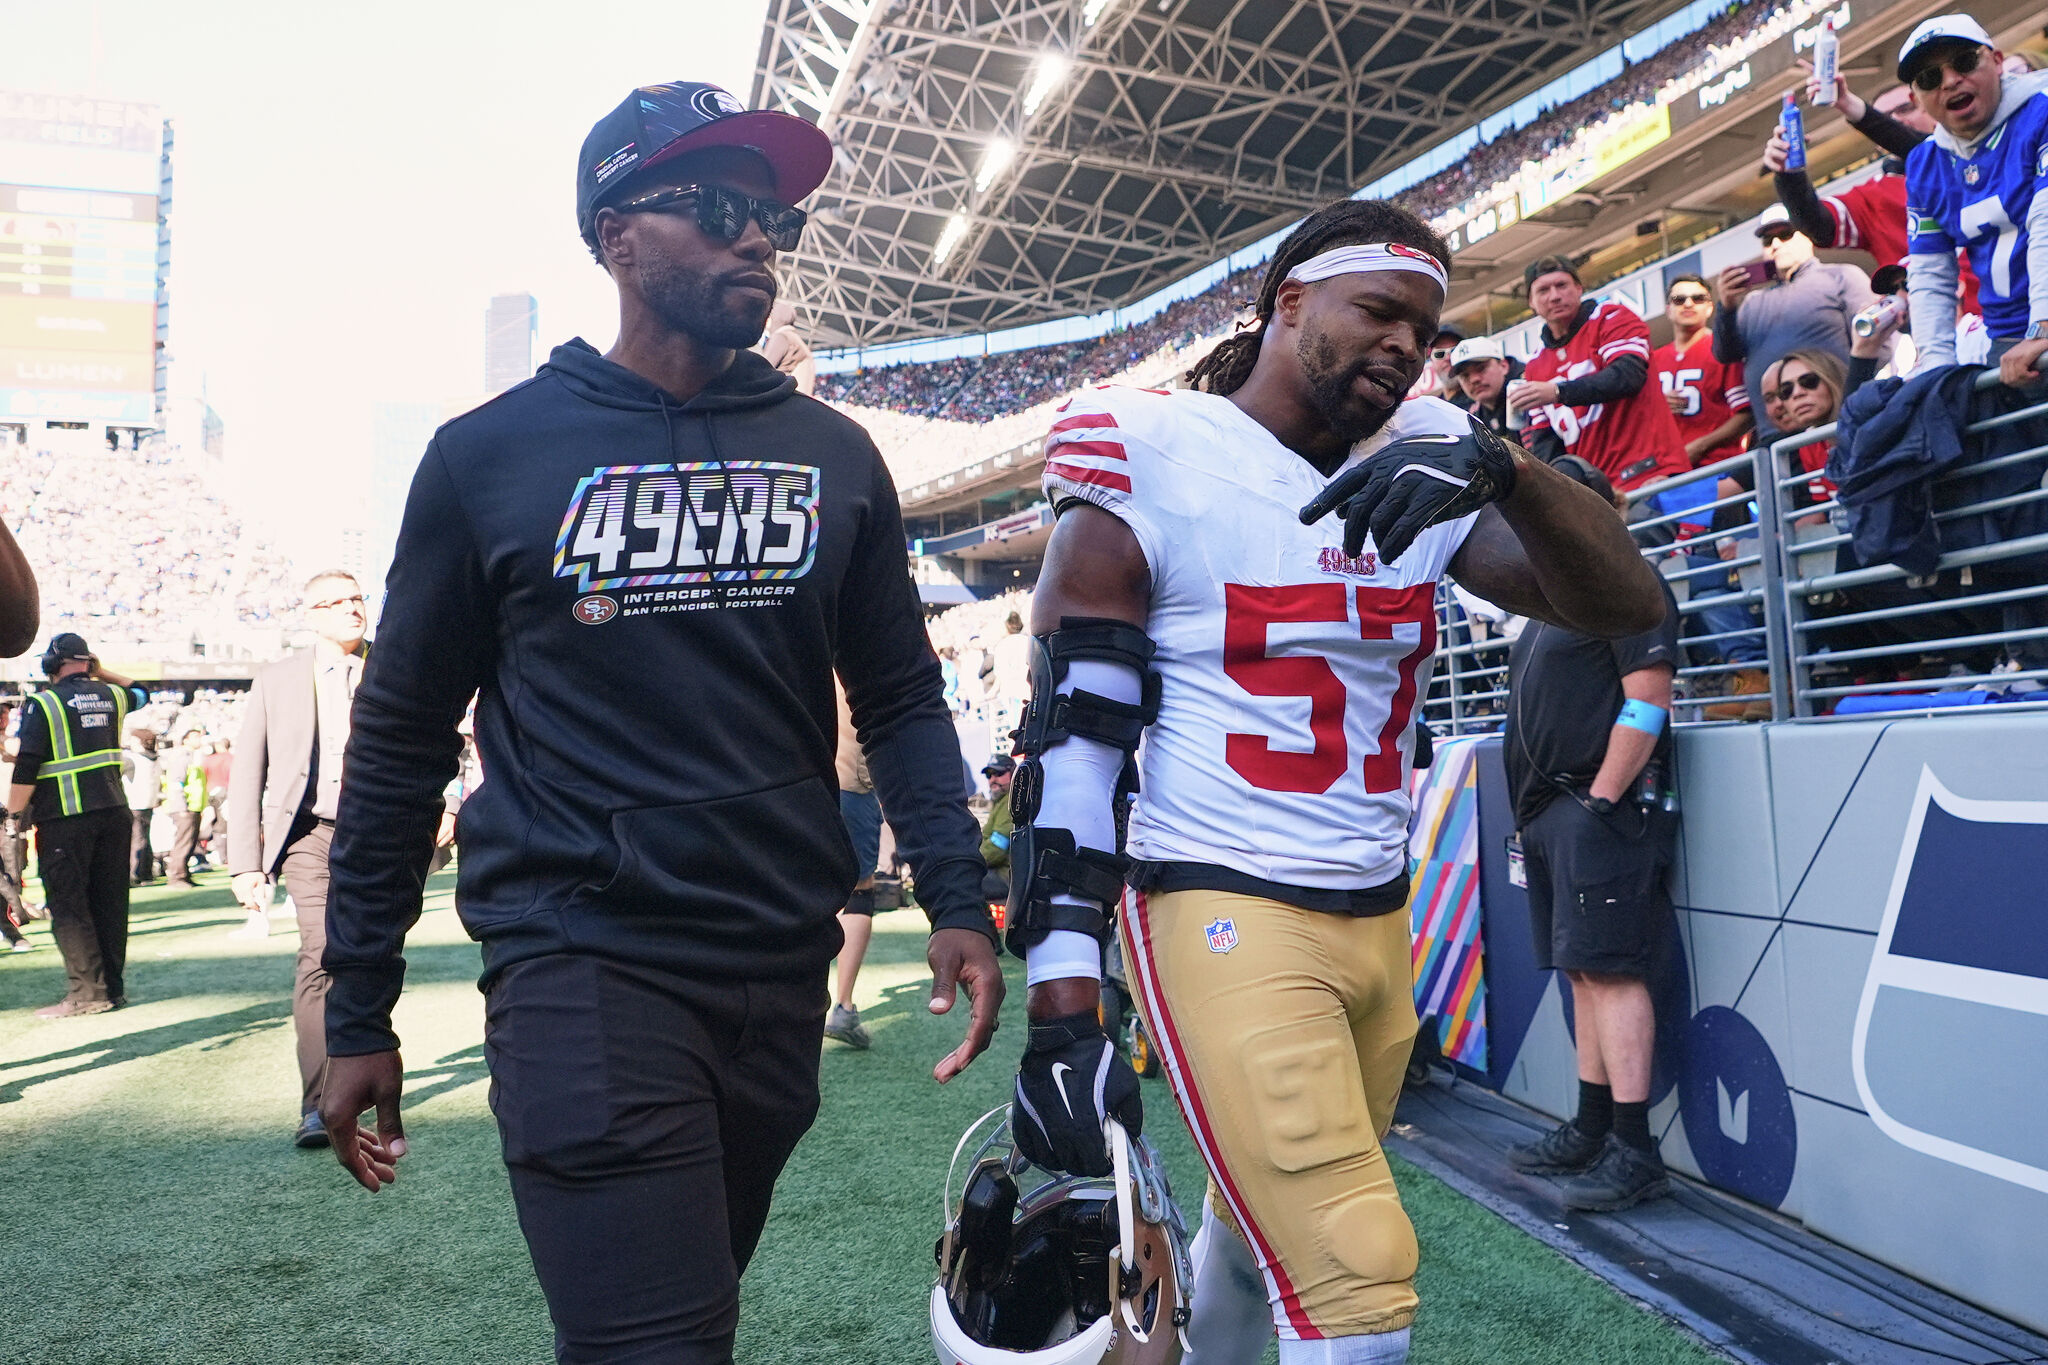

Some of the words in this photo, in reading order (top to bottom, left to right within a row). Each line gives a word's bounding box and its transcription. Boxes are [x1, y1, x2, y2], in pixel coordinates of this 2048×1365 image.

[1699, 61, 1750, 109] PayPal
[41, 123, 113, 145] FIELD
[612, 152, 628, 165] CATCH
[618, 153, 638, 167] CANCER
[1960, 194, 2018, 298] 7
[16, 362, 124, 382] LUMEN
[572, 473, 808, 573] 49ERS
[726, 585, 796, 598] CANCER
[623, 607, 650, 617] SAN
[725, 598, 784, 609] FOOTBALL
[1223, 581, 1437, 794] 57
[80, 712, 110, 728] SECURITY
[1212, 931, 1234, 948] NFL
